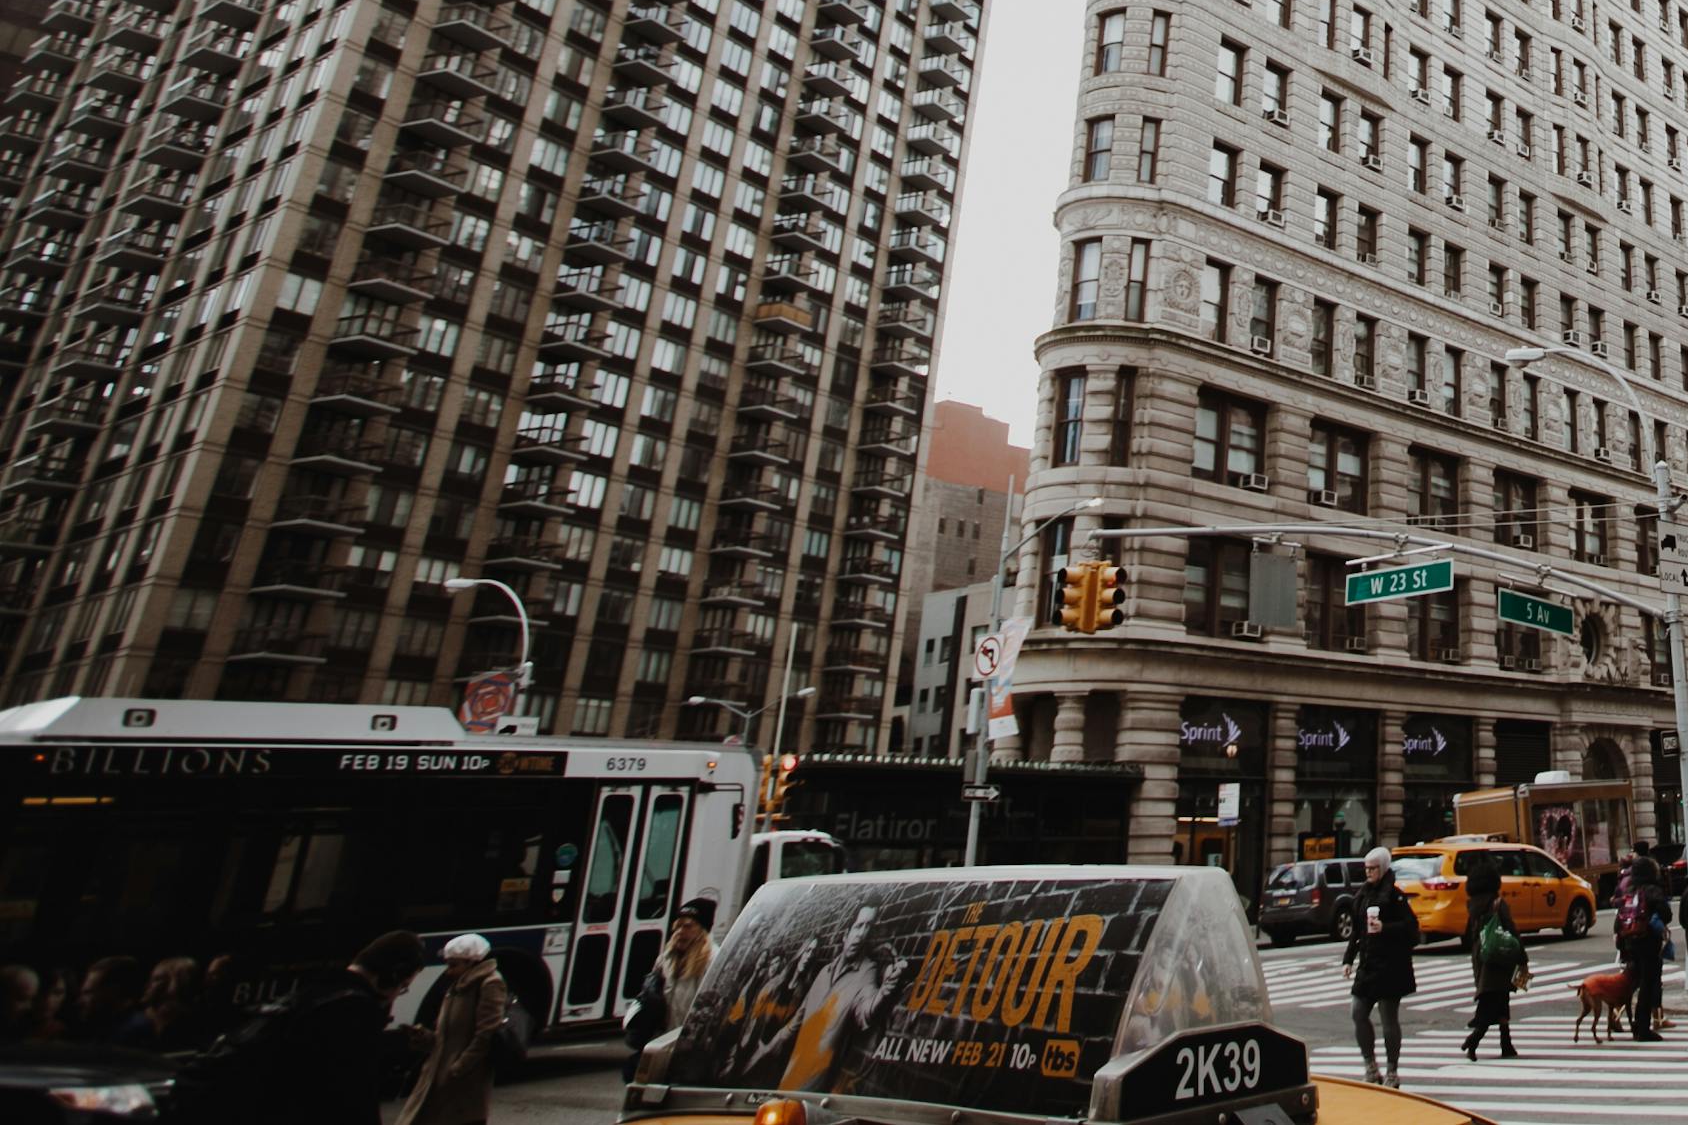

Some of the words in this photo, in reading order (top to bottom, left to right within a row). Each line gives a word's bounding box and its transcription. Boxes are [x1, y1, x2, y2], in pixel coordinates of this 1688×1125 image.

[1370, 577, 1383, 595] W
[1389, 573, 1407, 592] 23
[1412, 569, 1428, 588] St
[1526, 602, 1533, 620] 5
[1537, 606, 1550, 625] Av
[1180, 721, 1222, 747] Sprint
[1298, 729, 1334, 753] Sprint
[1402, 735, 1433, 757] Sprint
[51, 747, 273, 775] BILLIONS
[339, 754, 380, 770] FEB
[385, 754, 408, 770] 19
[416, 755, 457, 771] SUN
[606, 757, 647, 771] 6379
[962, 900, 989, 924] THE
[907, 914, 1104, 1034] DETOUR
[872, 1036, 904, 1060] ALL
[904, 1039, 952, 1064] NEW
[951, 1041, 984, 1067] FEB
[984, 1043, 1007, 1067] 21
[1175, 1038, 1261, 1100] 2K39
